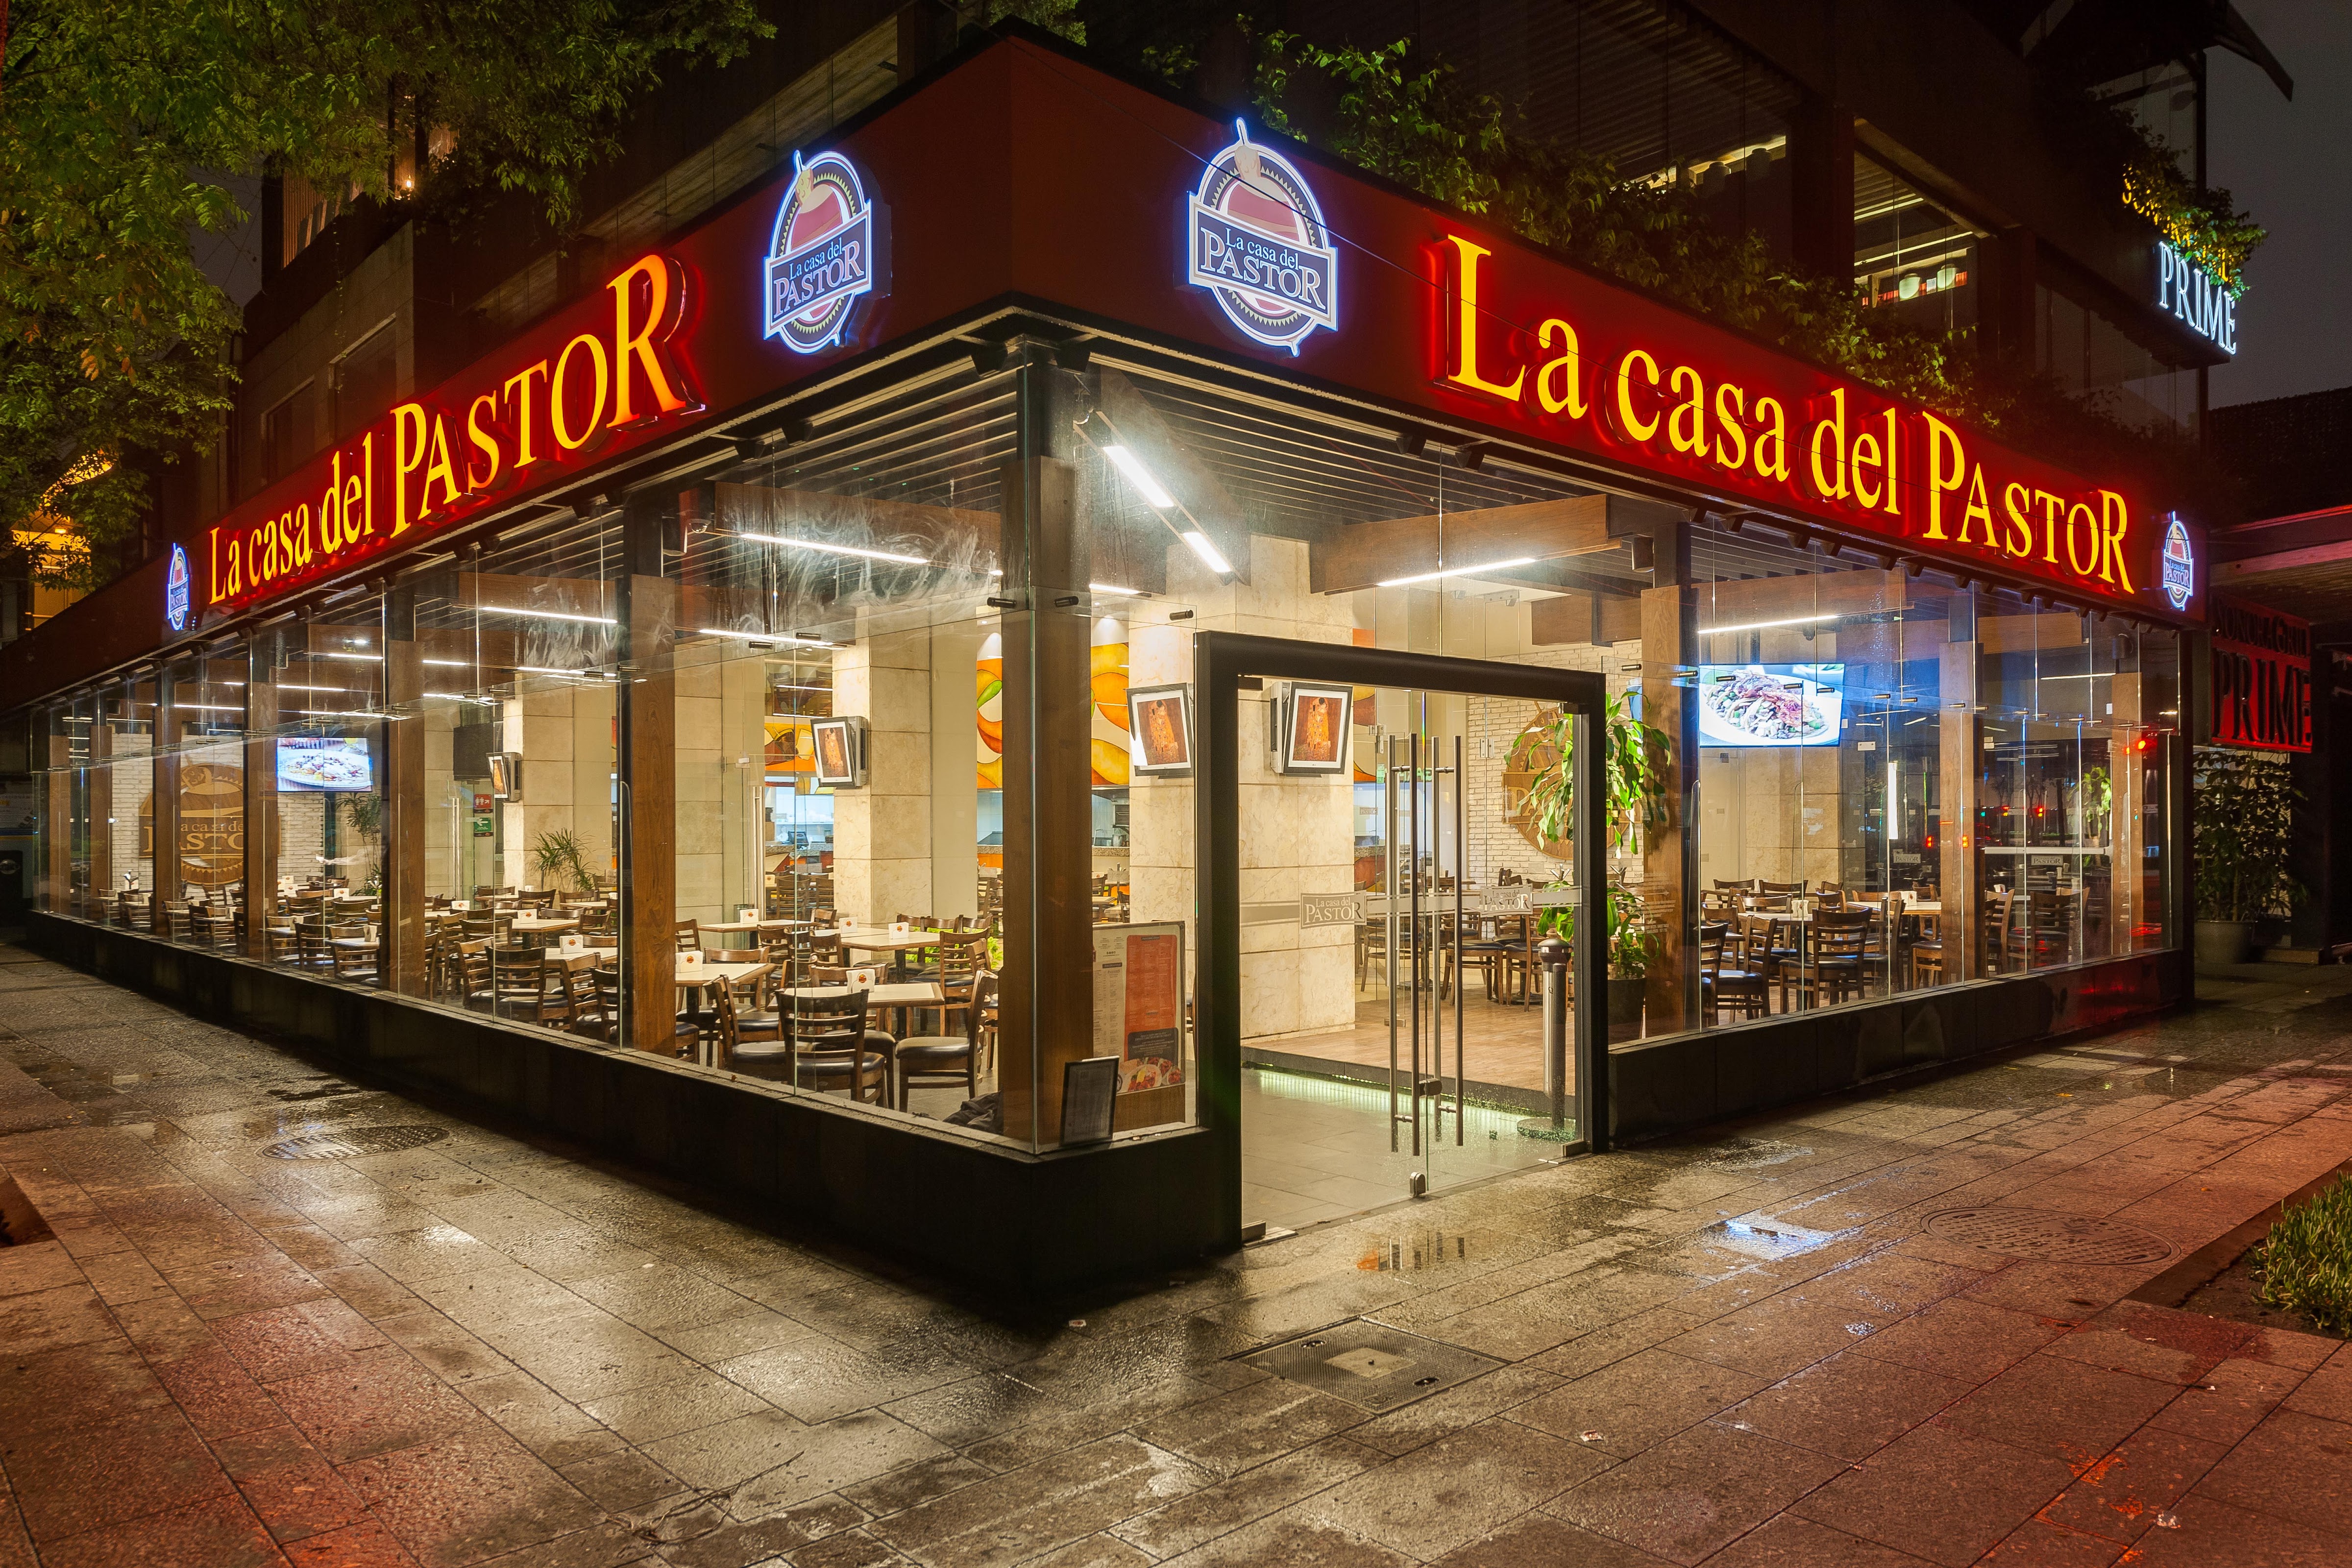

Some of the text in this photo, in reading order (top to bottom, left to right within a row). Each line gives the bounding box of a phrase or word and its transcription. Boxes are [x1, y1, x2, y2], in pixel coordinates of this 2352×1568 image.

[789, 237, 843, 280] La casa del
[1200, 227, 1326, 310] PASTOR
[1225, 227, 1299, 270] La casa del
[773, 240, 864, 318] PASTOR
[2158, 240, 2237, 356] PRIME
[209, 254, 686, 604] La casa del PASTOR
[1447, 234, 2134, 594] La casa del PASTOR
[2165, 562, 2190, 588] PASTOR
[2211, 647, 2312, 745] PRIME
[1304, 902, 1363, 924] PASTOR
[1316, 896, 1351, 907] La casa del
[1484, 893, 1530, 912] PASTOR
[1492, 890, 1499, 899] La
